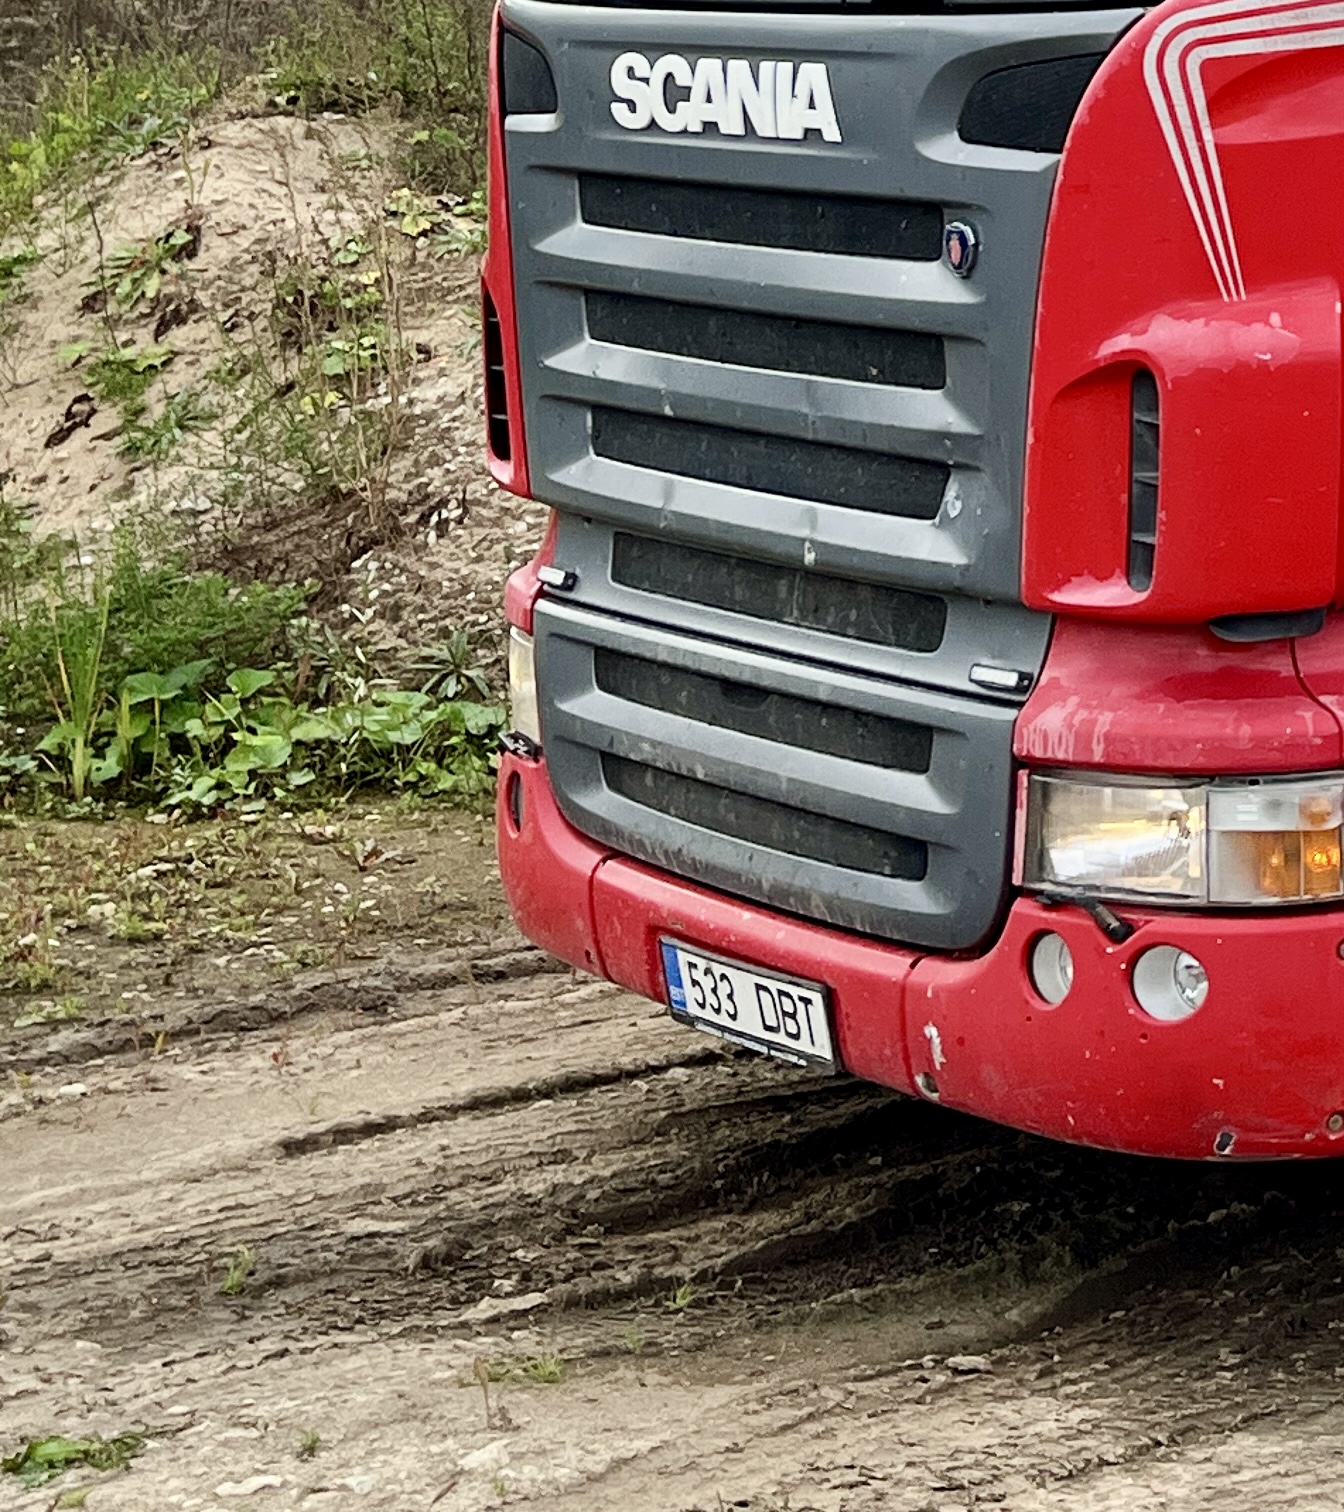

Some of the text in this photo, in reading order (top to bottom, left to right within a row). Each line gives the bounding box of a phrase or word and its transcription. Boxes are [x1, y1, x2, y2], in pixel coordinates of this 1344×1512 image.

[610, 51, 843, 143] SCANIA
[688, 961, 738, 1022] 533
[755, 983, 815, 1047] DBT
